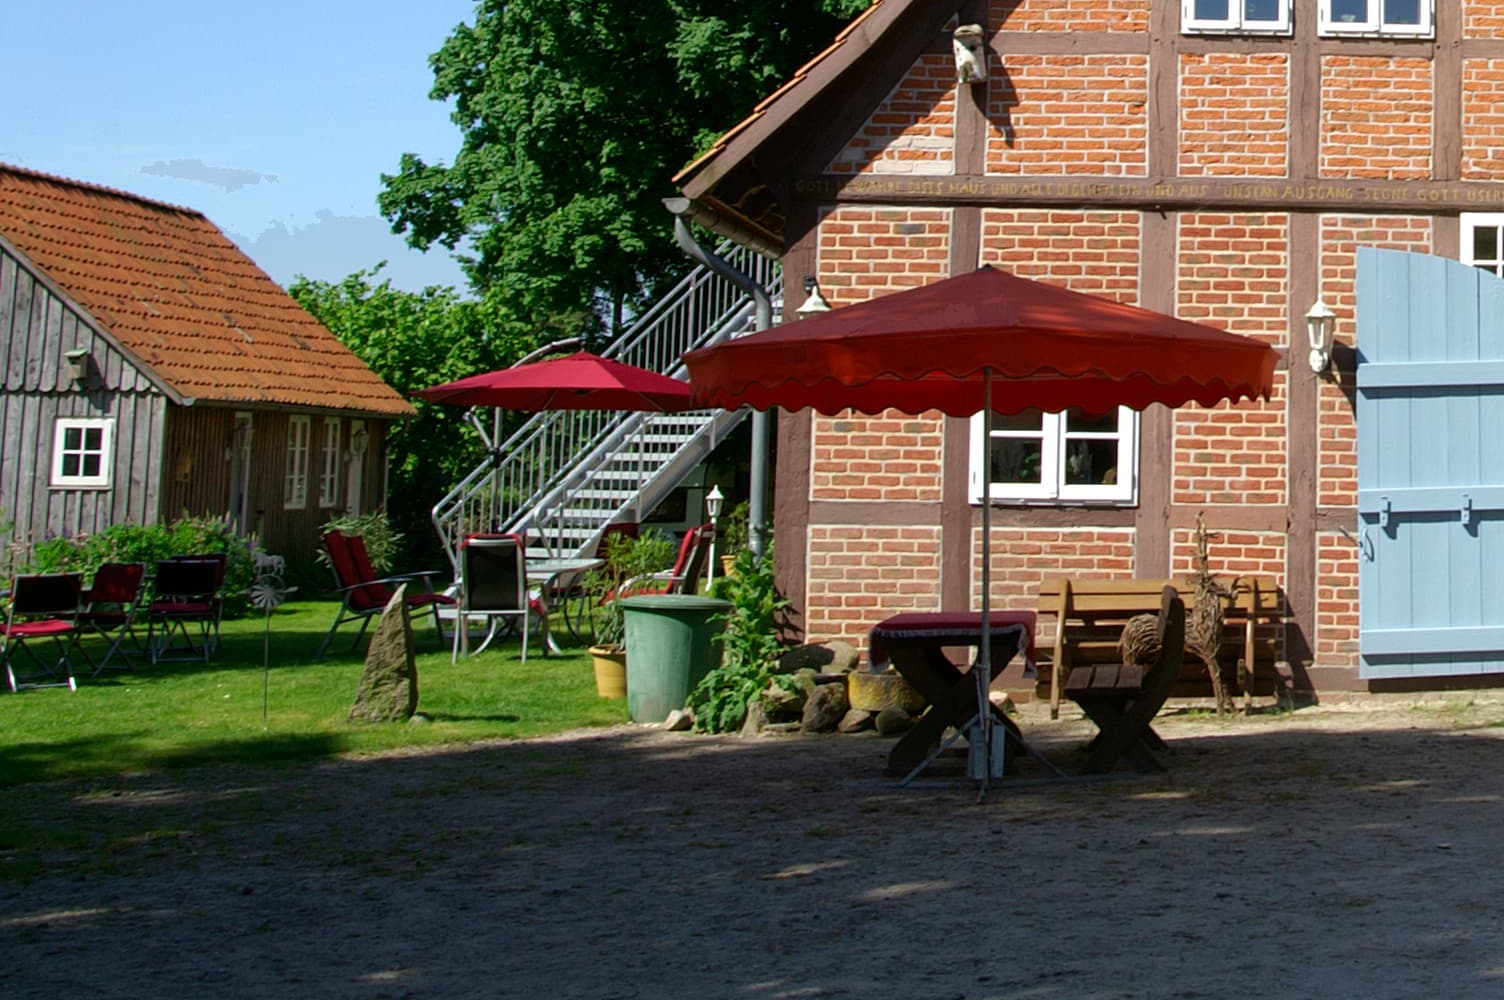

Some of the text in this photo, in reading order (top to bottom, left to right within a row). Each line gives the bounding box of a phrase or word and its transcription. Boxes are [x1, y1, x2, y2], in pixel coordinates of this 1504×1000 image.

[1281, 185, 1353, 200] AUSGANG
[1364, 186, 1409, 200] SEGNE
[1416, 188, 1461, 202] GOTT
